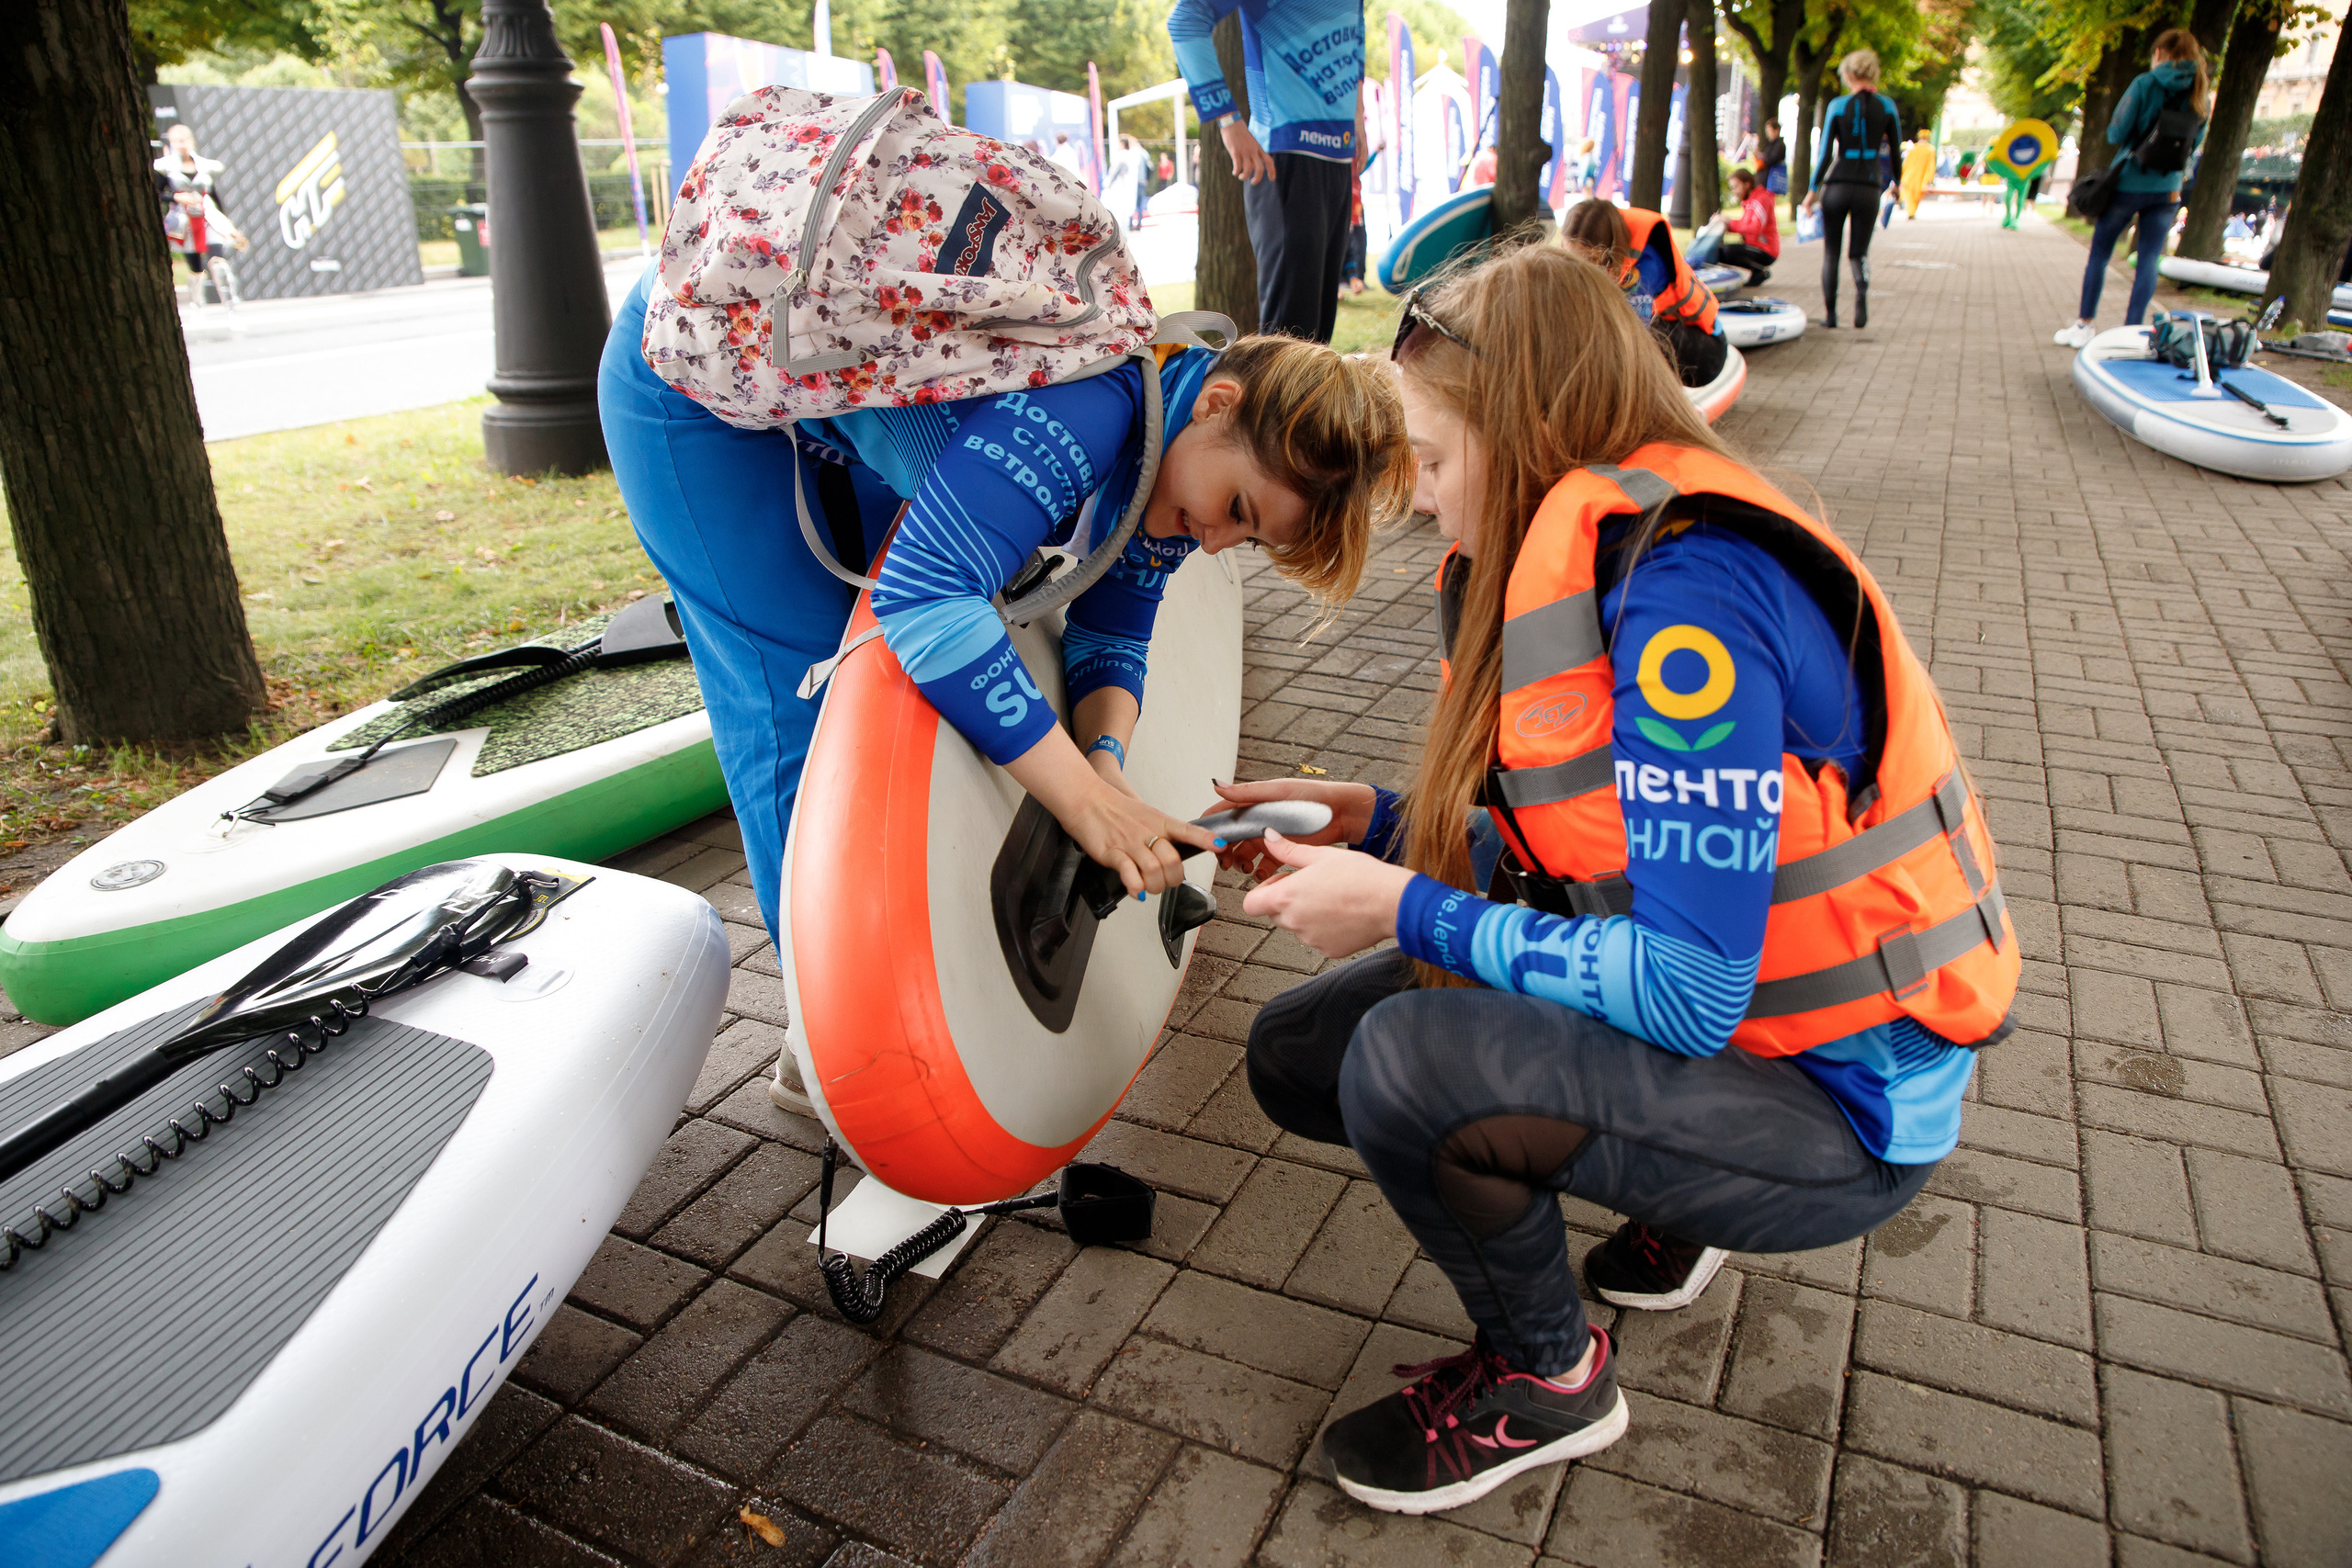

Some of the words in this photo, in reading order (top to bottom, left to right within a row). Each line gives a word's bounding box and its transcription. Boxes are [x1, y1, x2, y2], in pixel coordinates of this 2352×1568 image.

[1198, 89, 1233, 113] SUP
[1299, 130, 1341, 149] лента
[954, 196, 998, 276] JANSPOR
[994, 392, 1095, 496] Доставл
[970, 643, 1018, 691] ФОНТ
[985, 658, 1044, 728] SU
[1614, 760, 1783, 815] лента
[1623, 816, 1781, 874] нлай
[1510, 911, 1586, 996] SU
